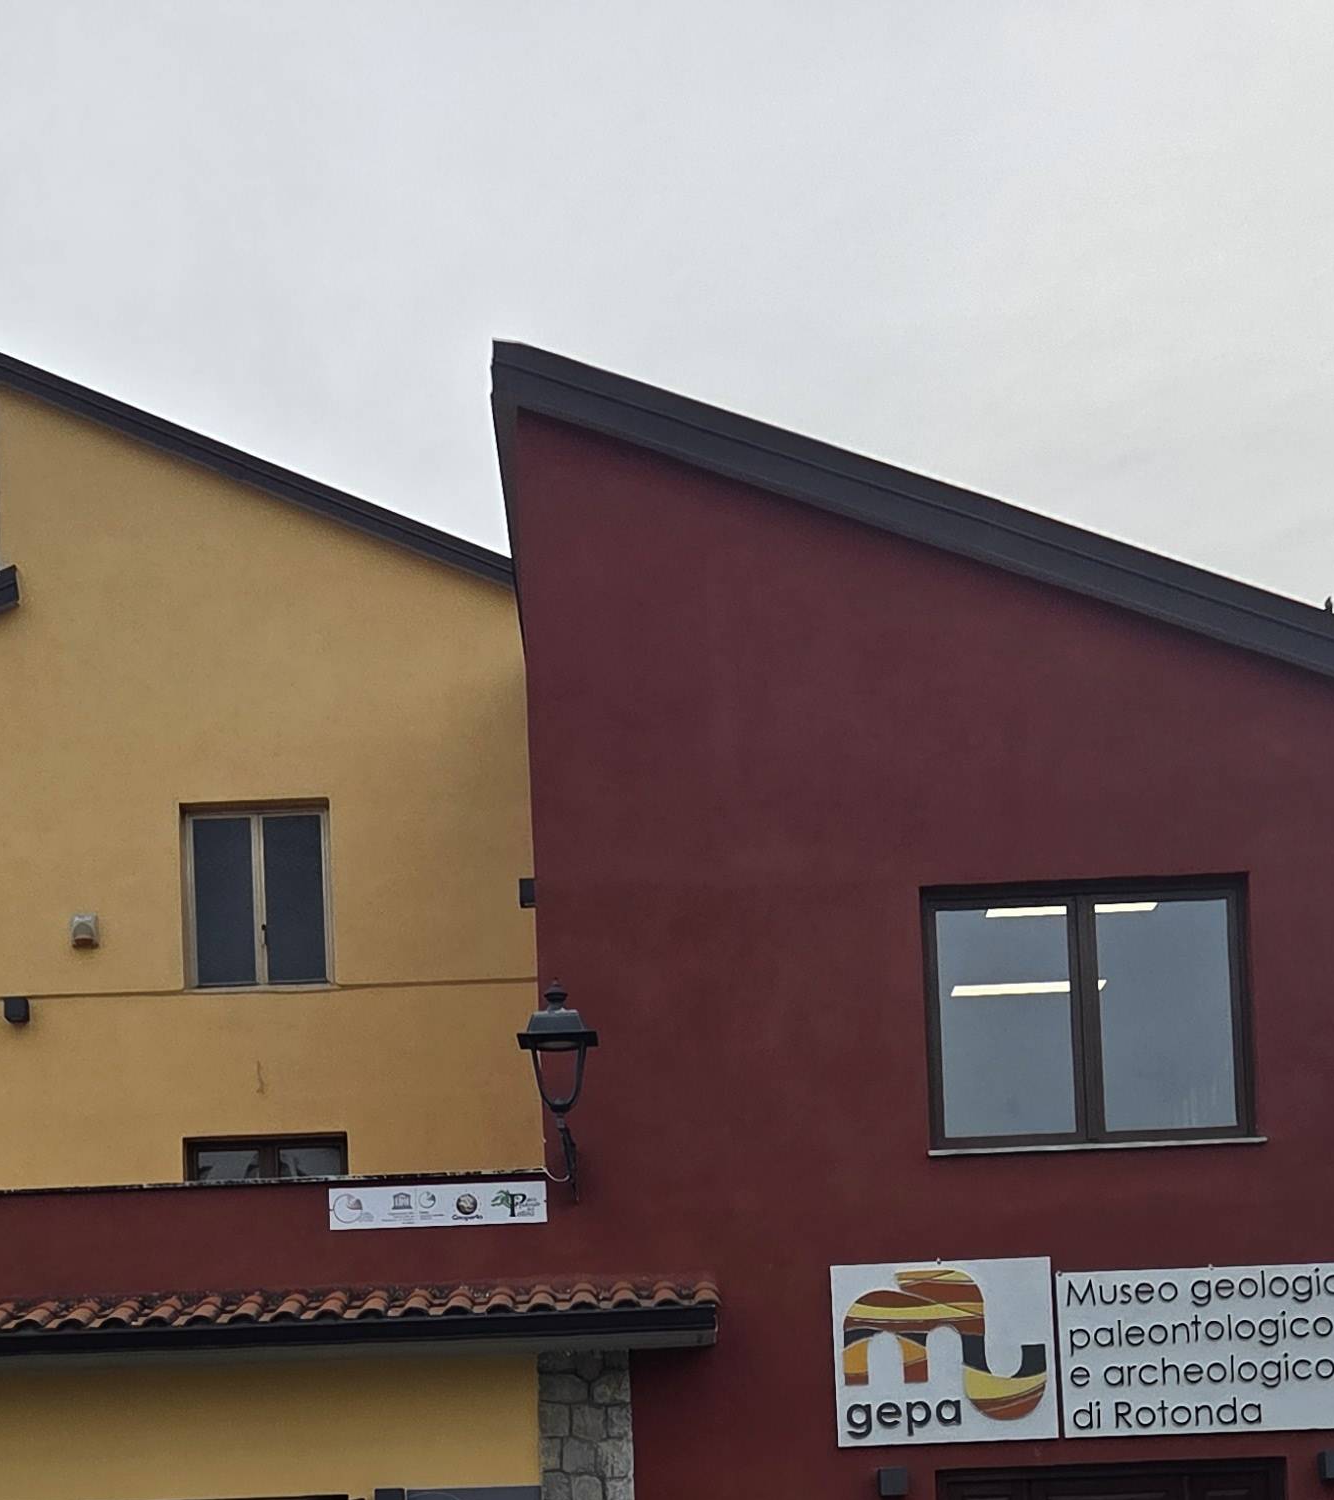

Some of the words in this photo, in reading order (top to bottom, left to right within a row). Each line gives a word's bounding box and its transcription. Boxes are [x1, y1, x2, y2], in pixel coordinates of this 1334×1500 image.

[1066, 1278, 1178, 1307] Museo
[1069, 1310, 1334, 1357] paleontologico
[1070, 1366, 1091, 1388] e
[846, 1399, 962, 1440] gepa
[1073, 1401, 1101, 1430] di
[1114, 1397, 1264, 1429] Rotonda
